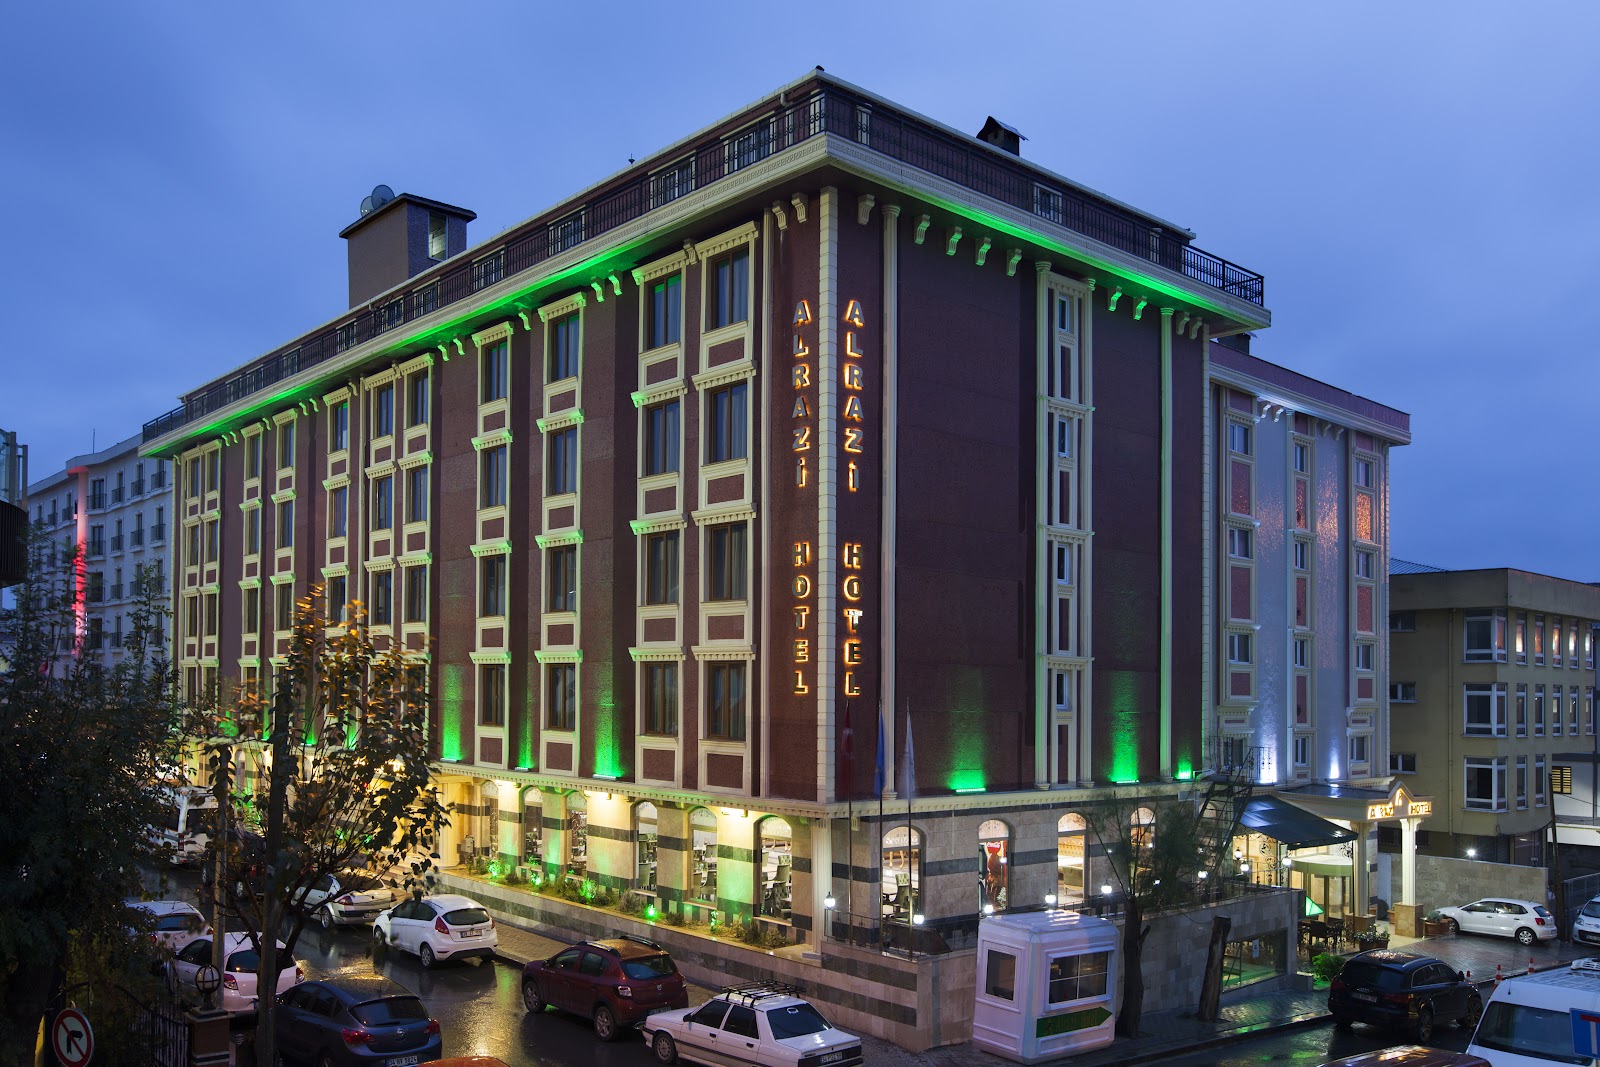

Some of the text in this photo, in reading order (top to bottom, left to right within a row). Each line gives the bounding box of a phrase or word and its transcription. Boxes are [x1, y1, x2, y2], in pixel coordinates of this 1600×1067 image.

[792, 542, 811, 695] HOTEL
[844, 543, 864, 695] HOTEL
[1410, 804, 1431, 815] HOTEL
